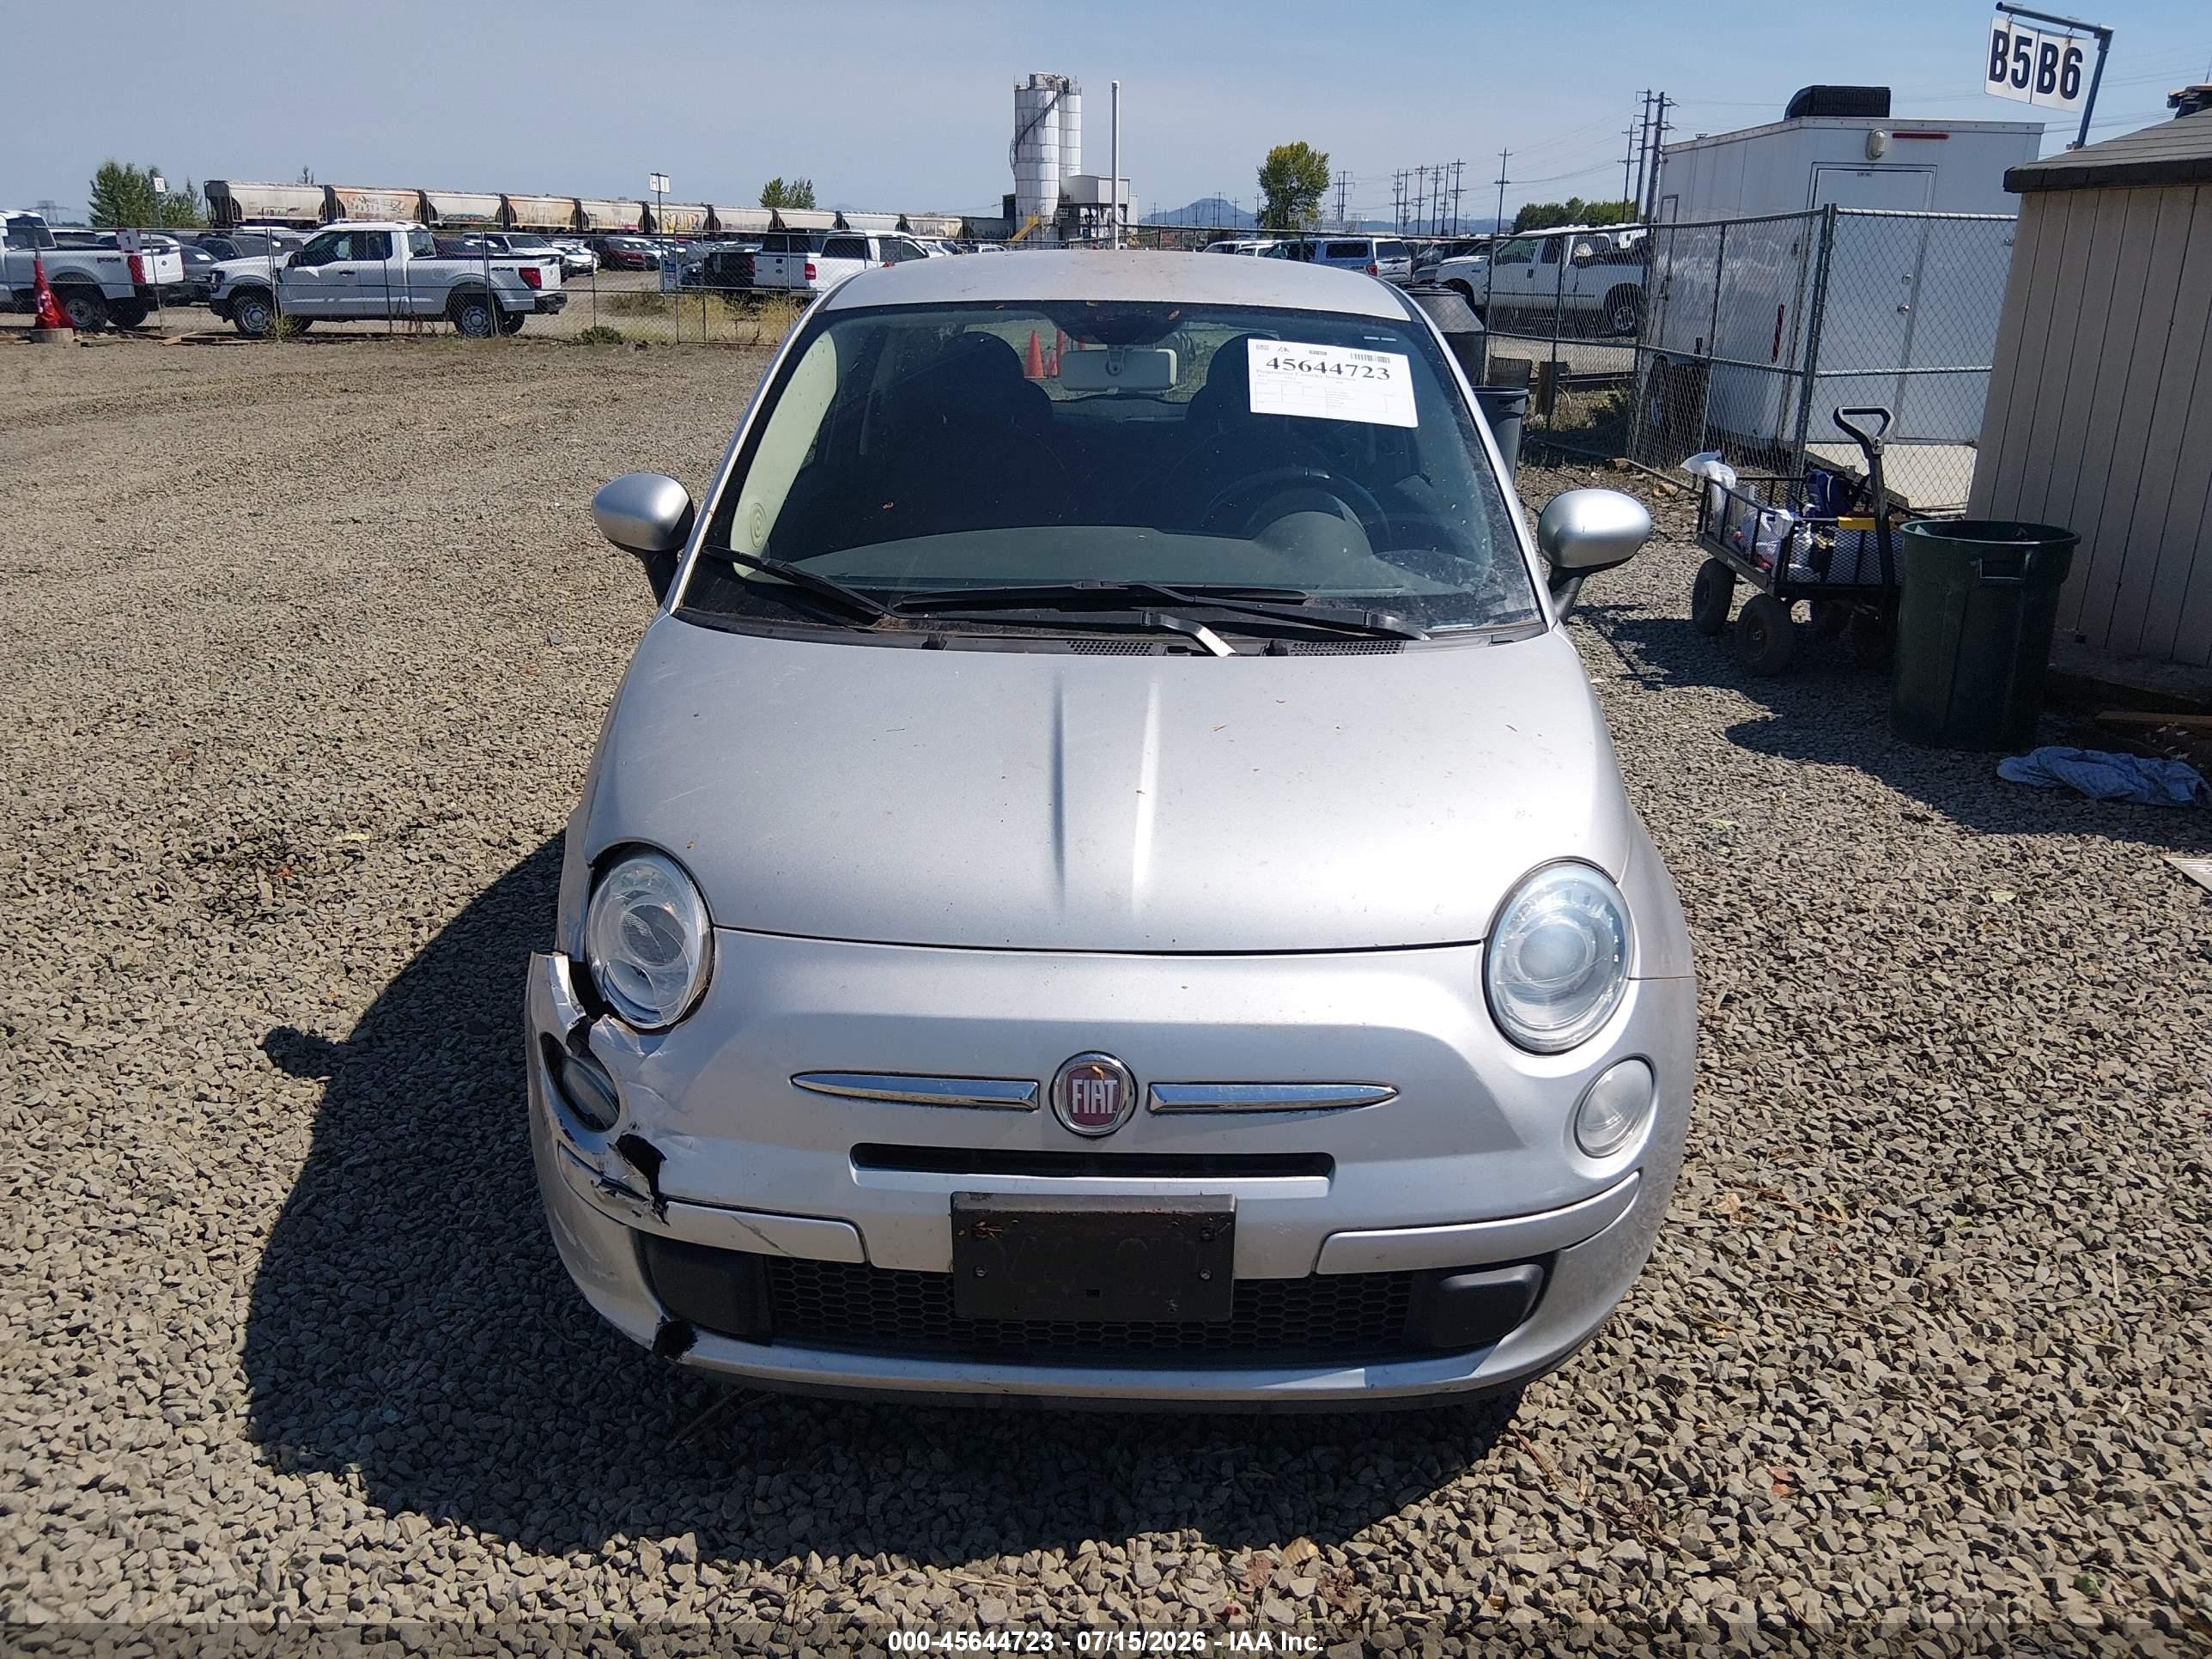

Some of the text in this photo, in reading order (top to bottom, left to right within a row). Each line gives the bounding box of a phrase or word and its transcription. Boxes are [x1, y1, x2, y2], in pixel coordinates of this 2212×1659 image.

[1989, 29, 2083, 100] B5 B6
[155, 179, 164, 191] 30
[1072, 220, 1118, 255] FIAT
[1266, 356, 1390, 380] 45644723
